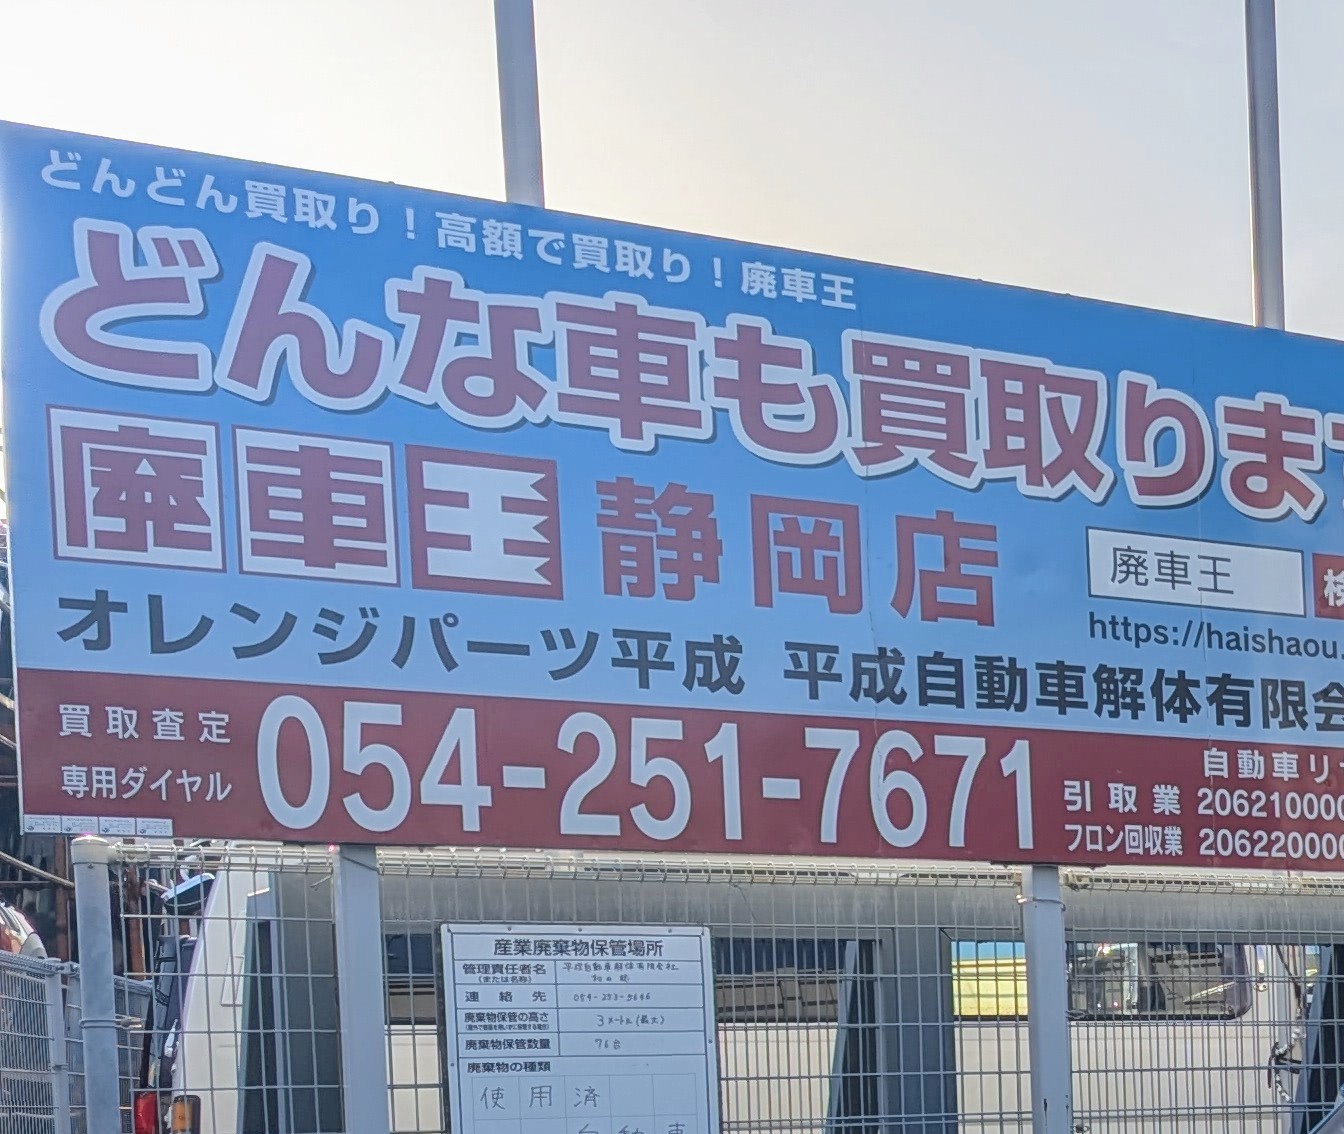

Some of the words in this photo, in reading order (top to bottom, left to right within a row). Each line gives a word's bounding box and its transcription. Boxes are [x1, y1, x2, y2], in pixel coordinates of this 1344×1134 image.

[1110, 546, 1234, 595] 廃車王
[57, 590, 744, 694] オレンジパーツ平成
[59, 705, 231, 745] 買取査定
[61, 764, 232, 803] 専用ダイヤル
[256, 695, 1036, 852] 054-251-7671
[1063, 780, 1181, 816] 引取業
[1064, 823, 1183, 857] フロン回収業
[493, 938, 664, 957] 産業廃棄物保管場所
[480, 1085, 600, 1110] 使用済
